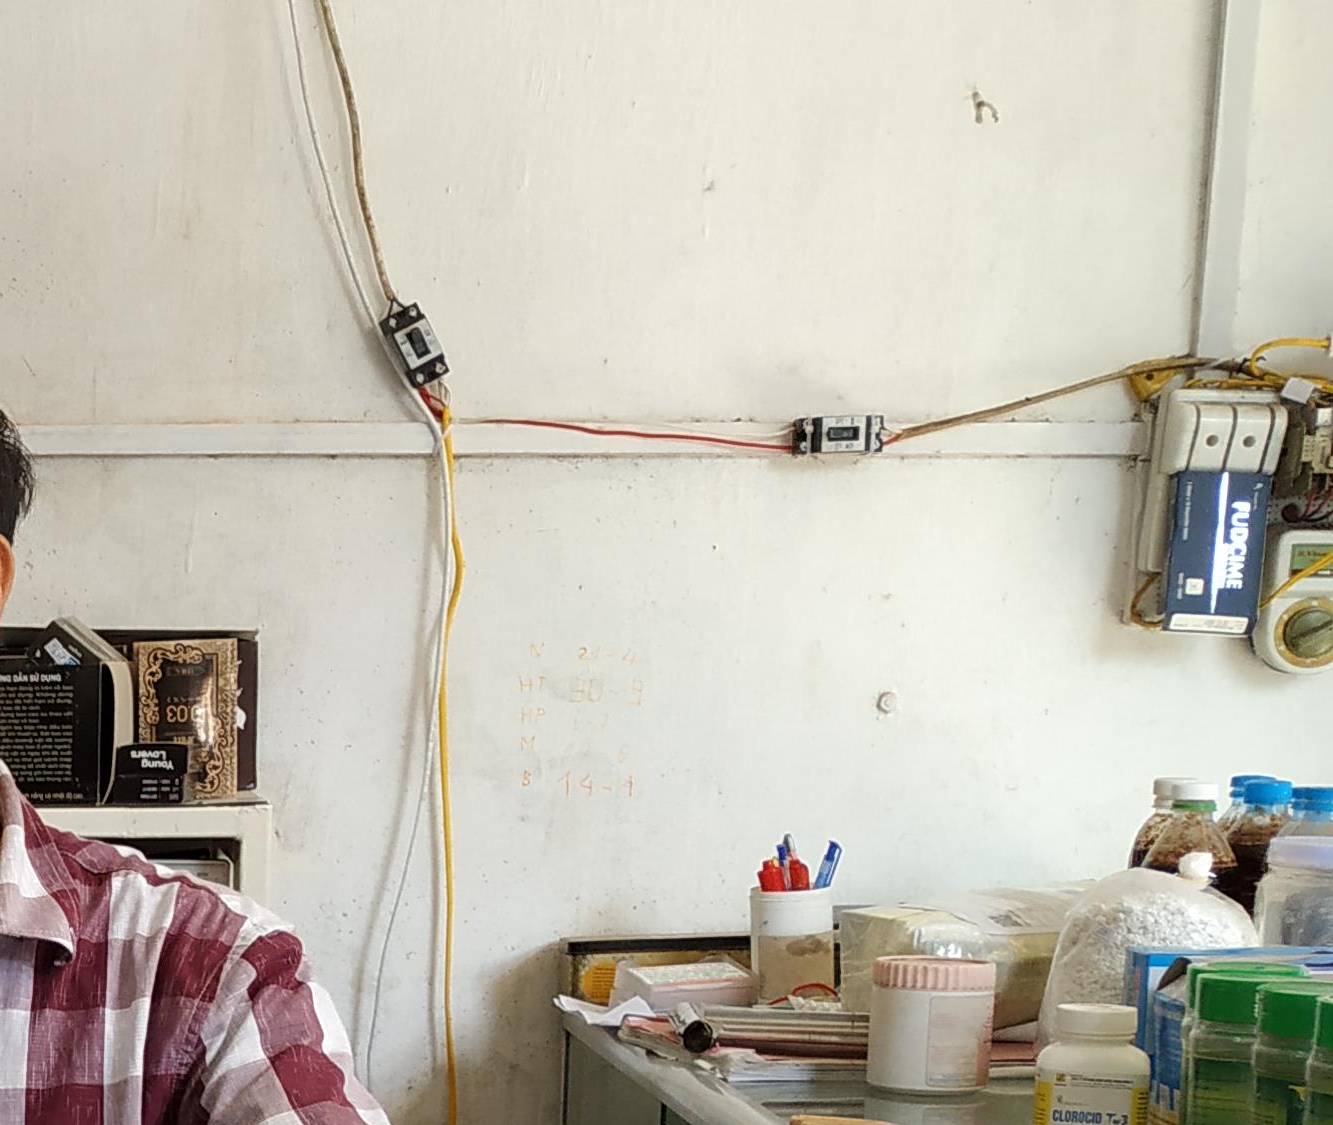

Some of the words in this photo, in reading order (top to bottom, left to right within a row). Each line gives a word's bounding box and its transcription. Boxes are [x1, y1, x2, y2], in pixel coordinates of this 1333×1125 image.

[1225, 501, 1251, 590] FUDCIME
[141, 758, 175, 772] Young
[1052, 1109, 1102, 1125] CLOROCID
